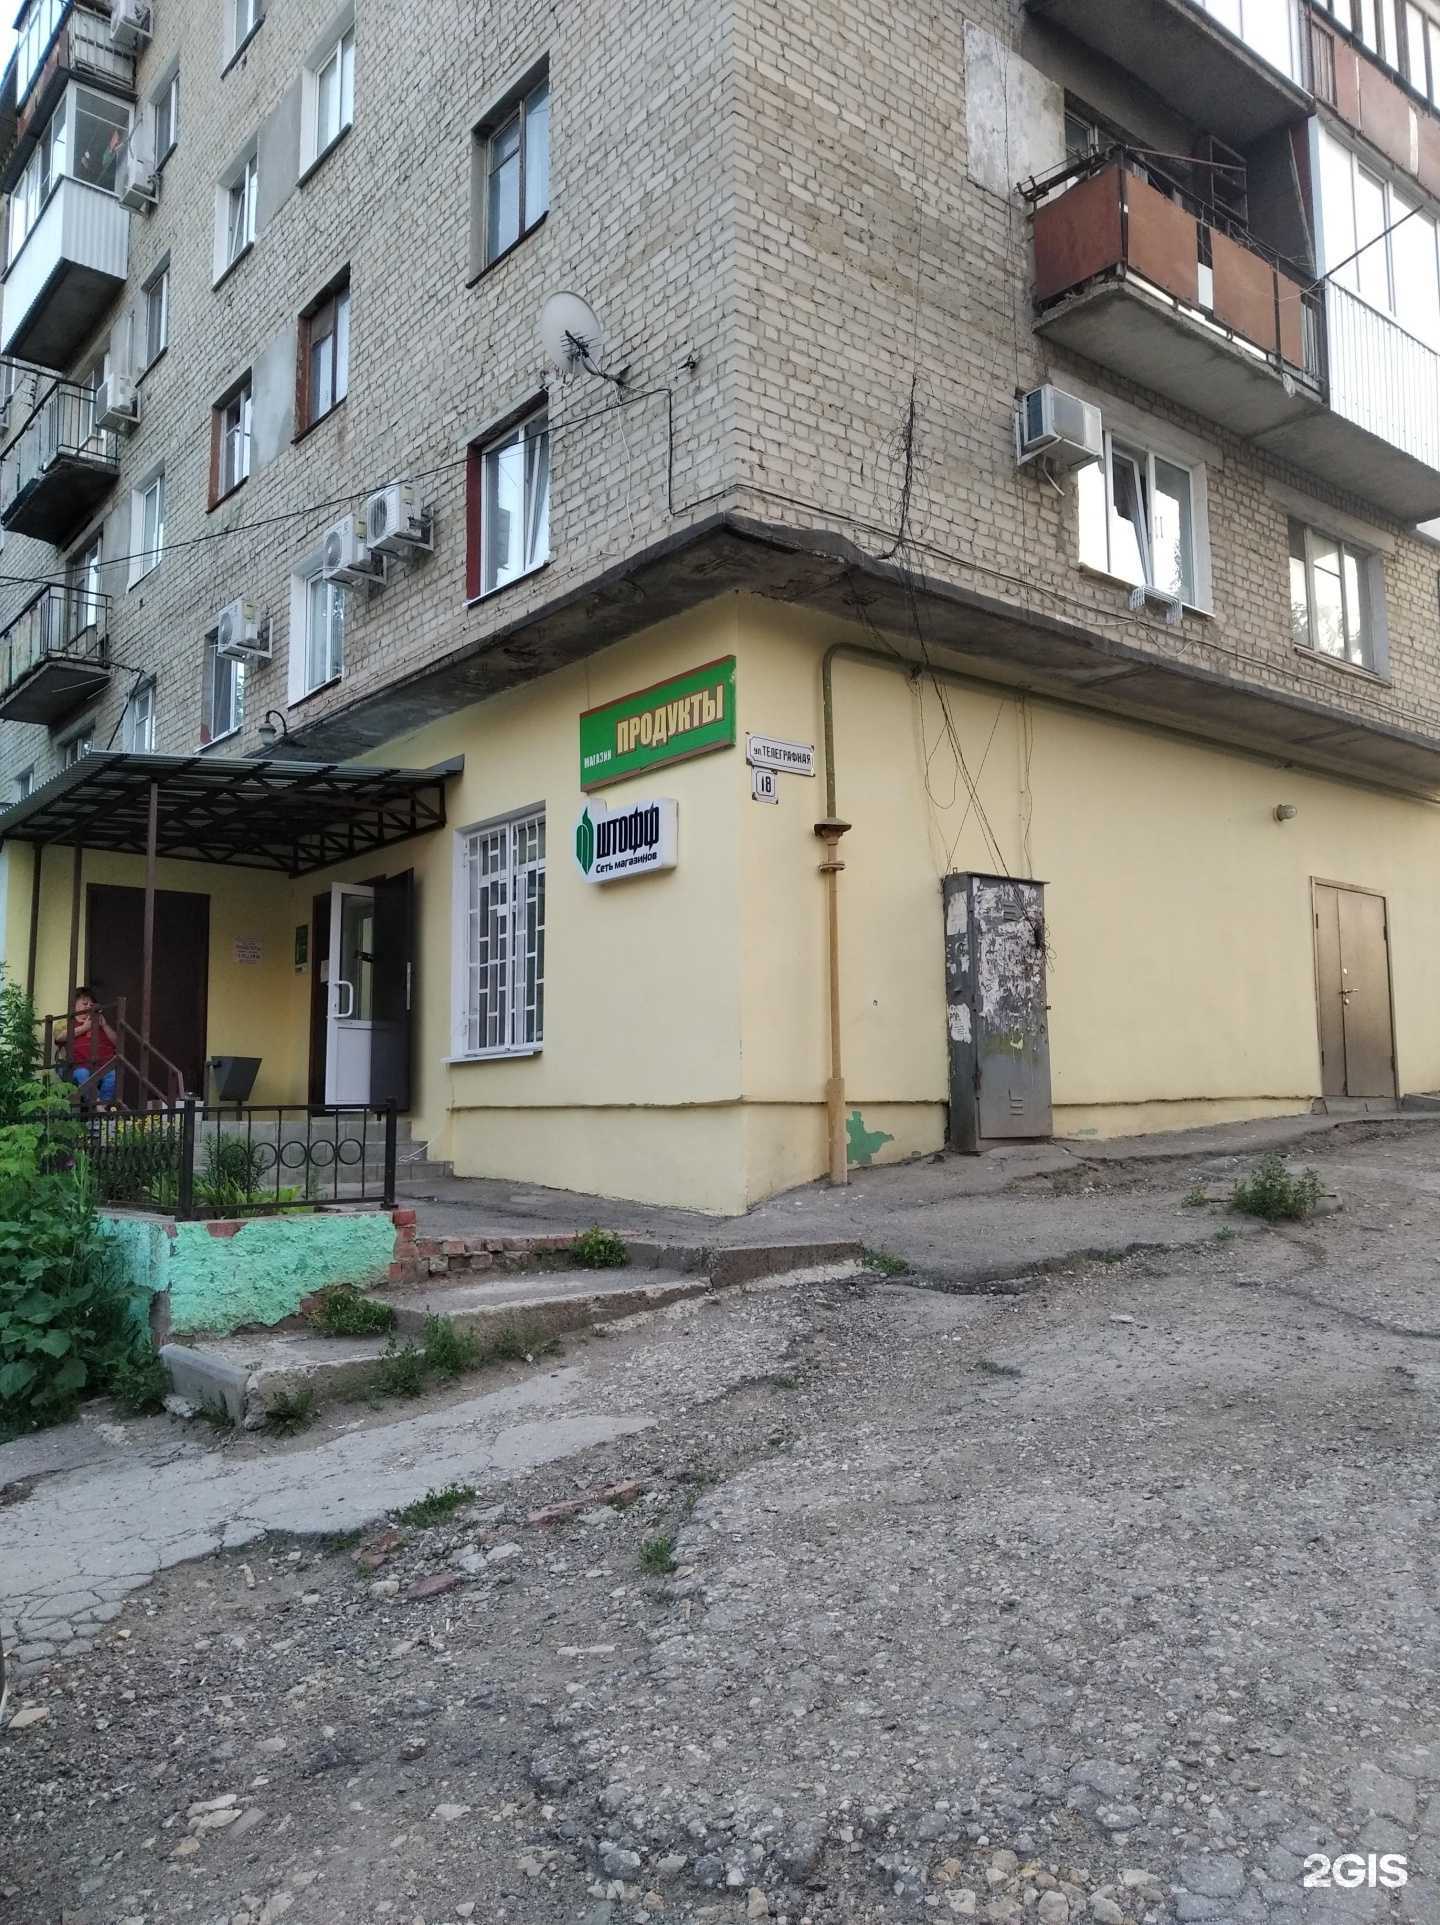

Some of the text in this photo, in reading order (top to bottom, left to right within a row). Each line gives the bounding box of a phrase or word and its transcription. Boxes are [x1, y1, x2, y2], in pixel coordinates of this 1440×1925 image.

[584, 685, 724, 768] МАГАЗИН ПРОДУКТЫ
[762, 745, 811, 764] ТЕЛЕГРАФНАЯ
[761, 776, 771, 792] 18
[596, 802, 660, 859] ШТОФФ
[596, 852, 657, 873] Сеть магазинов
